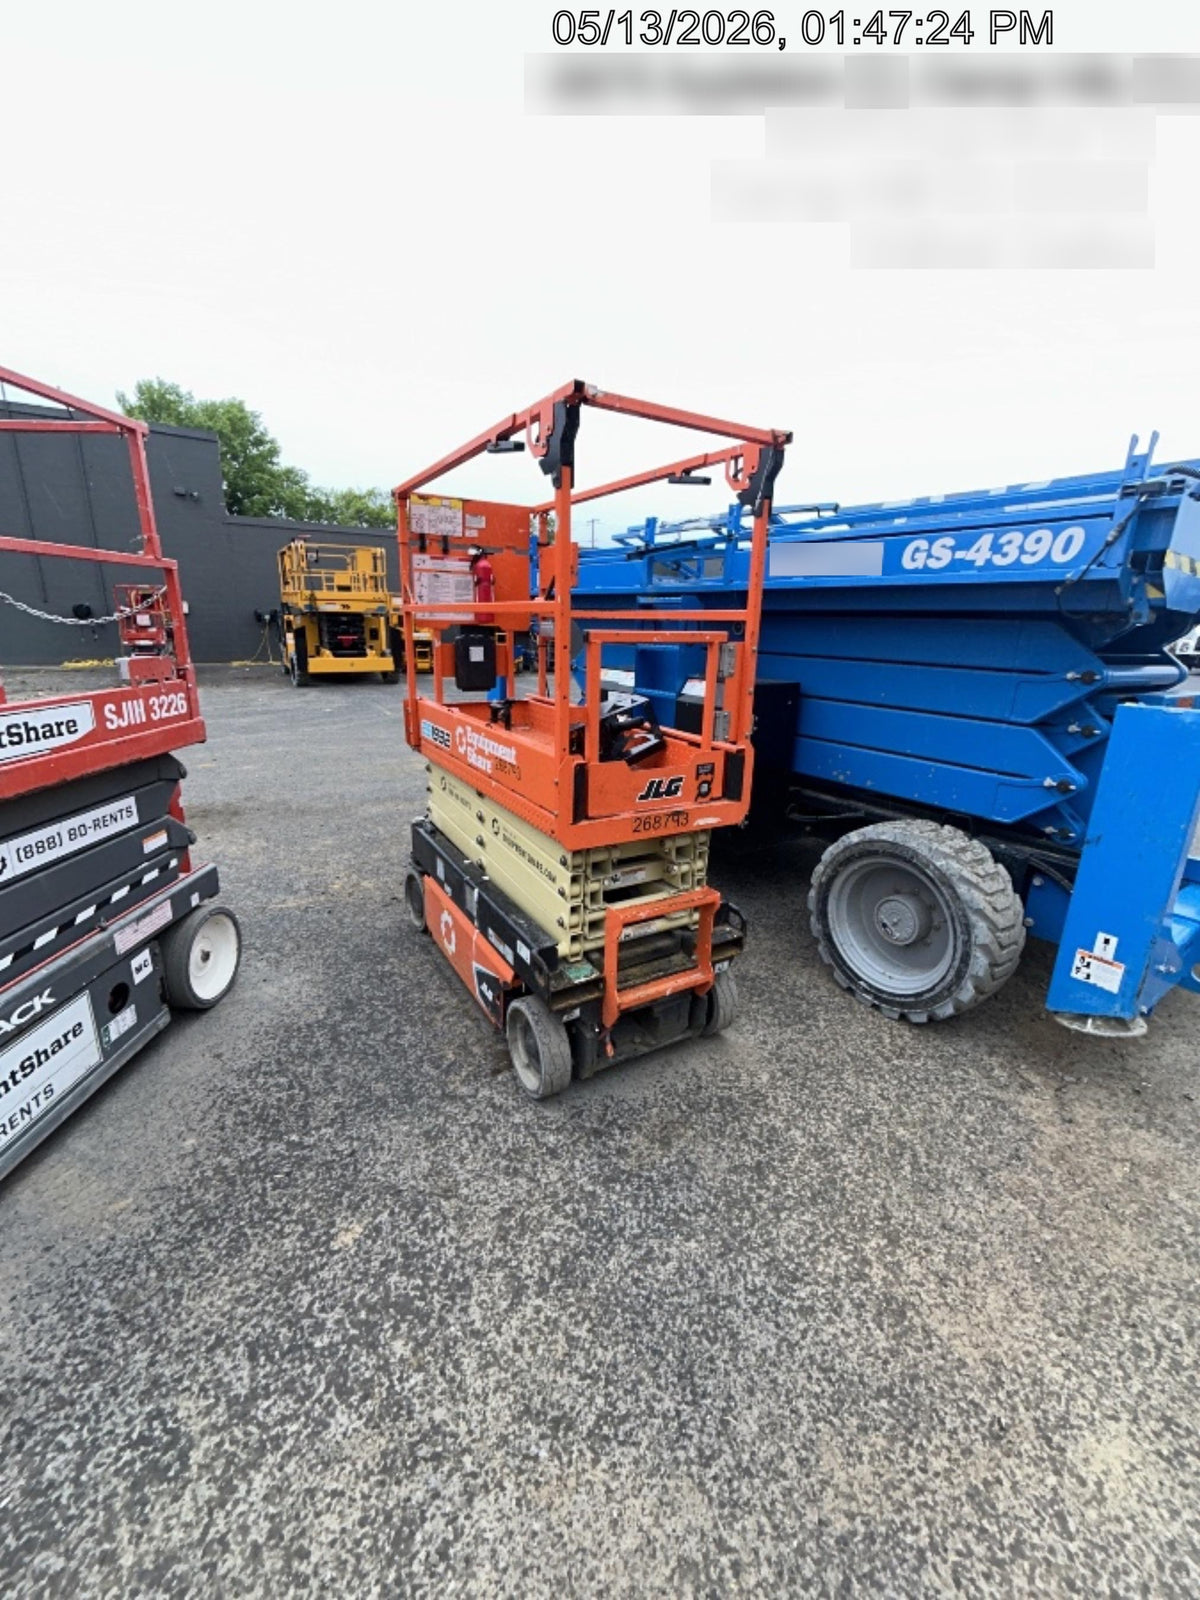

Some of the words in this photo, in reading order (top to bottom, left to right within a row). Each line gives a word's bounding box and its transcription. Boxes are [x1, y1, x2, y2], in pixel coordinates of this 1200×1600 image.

[901, 526, 1086, 570] GS-4390
[149, 692, 187, 720] 3226
[636, 775, 685, 802] JLG
[16, 831, 63, 863] (888)
[67, 805, 134, 842] 80-RENTS
[632, 811, 689, 833] 268793
